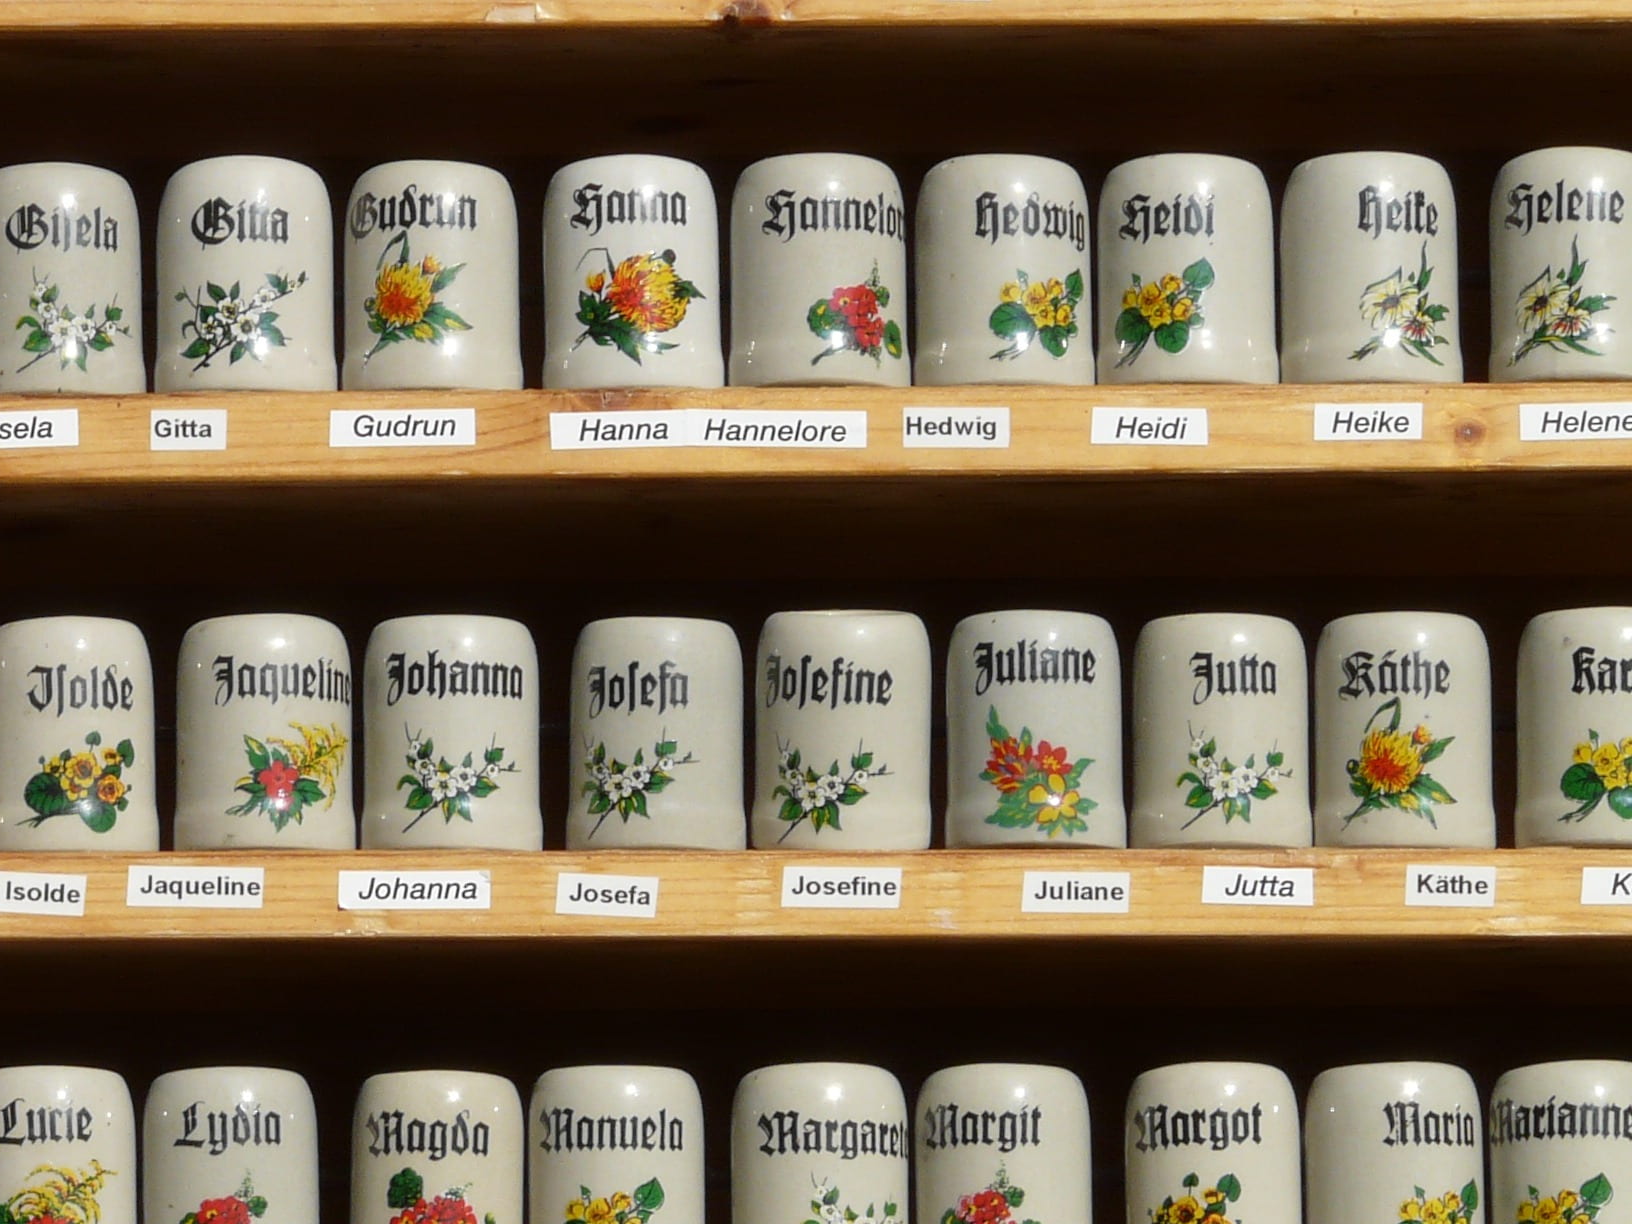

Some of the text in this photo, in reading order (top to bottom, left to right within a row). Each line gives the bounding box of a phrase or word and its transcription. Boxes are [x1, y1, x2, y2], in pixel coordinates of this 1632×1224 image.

[569, 182, 687, 237] Hanna
[1118, 193, 1214, 241] Heidi
[1504, 179, 1625, 231] Helene
[154, 419, 212, 438] Gitta
[353, 414, 456, 438] Gudrun
[579, 418, 668, 442] Hanna
[704, 418, 847, 442] Hannelore
[906, 416, 996, 441] Hedwig
[1115, 416, 1187, 440] Heidi
[1332, 411, 1410, 434] Heike
[1541, 410, 1632, 433] Helene
[386, 649, 523, 707] Johanna
[973, 639, 1096, 697] Juliane
[1188, 651, 1277, 706] Jutta
[6, 880, 81, 904] Isolde
[140, 875, 261, 900] Jaqueline
[358, 877, 477, 900] Johanna
[569, 882, 650, 905] Josefa
[791, 875, 897, 896] Josefine
[1034, 880, 1124, 901] Juliane
[1225, 873, 1294, 897] Jutta
[1417, 874, 1489, 895] Käthe
[173, 1102, 281, 1156] Lydia
[365, 1109, 490, 1162] Magda
[539, 1107, 683, 1153] Manuela
[924, 1102, 1042, 1154] Margit
[1133, 1102, 1262, 1153] Margot
[1382, 1101, 1475, 1148] Maria
